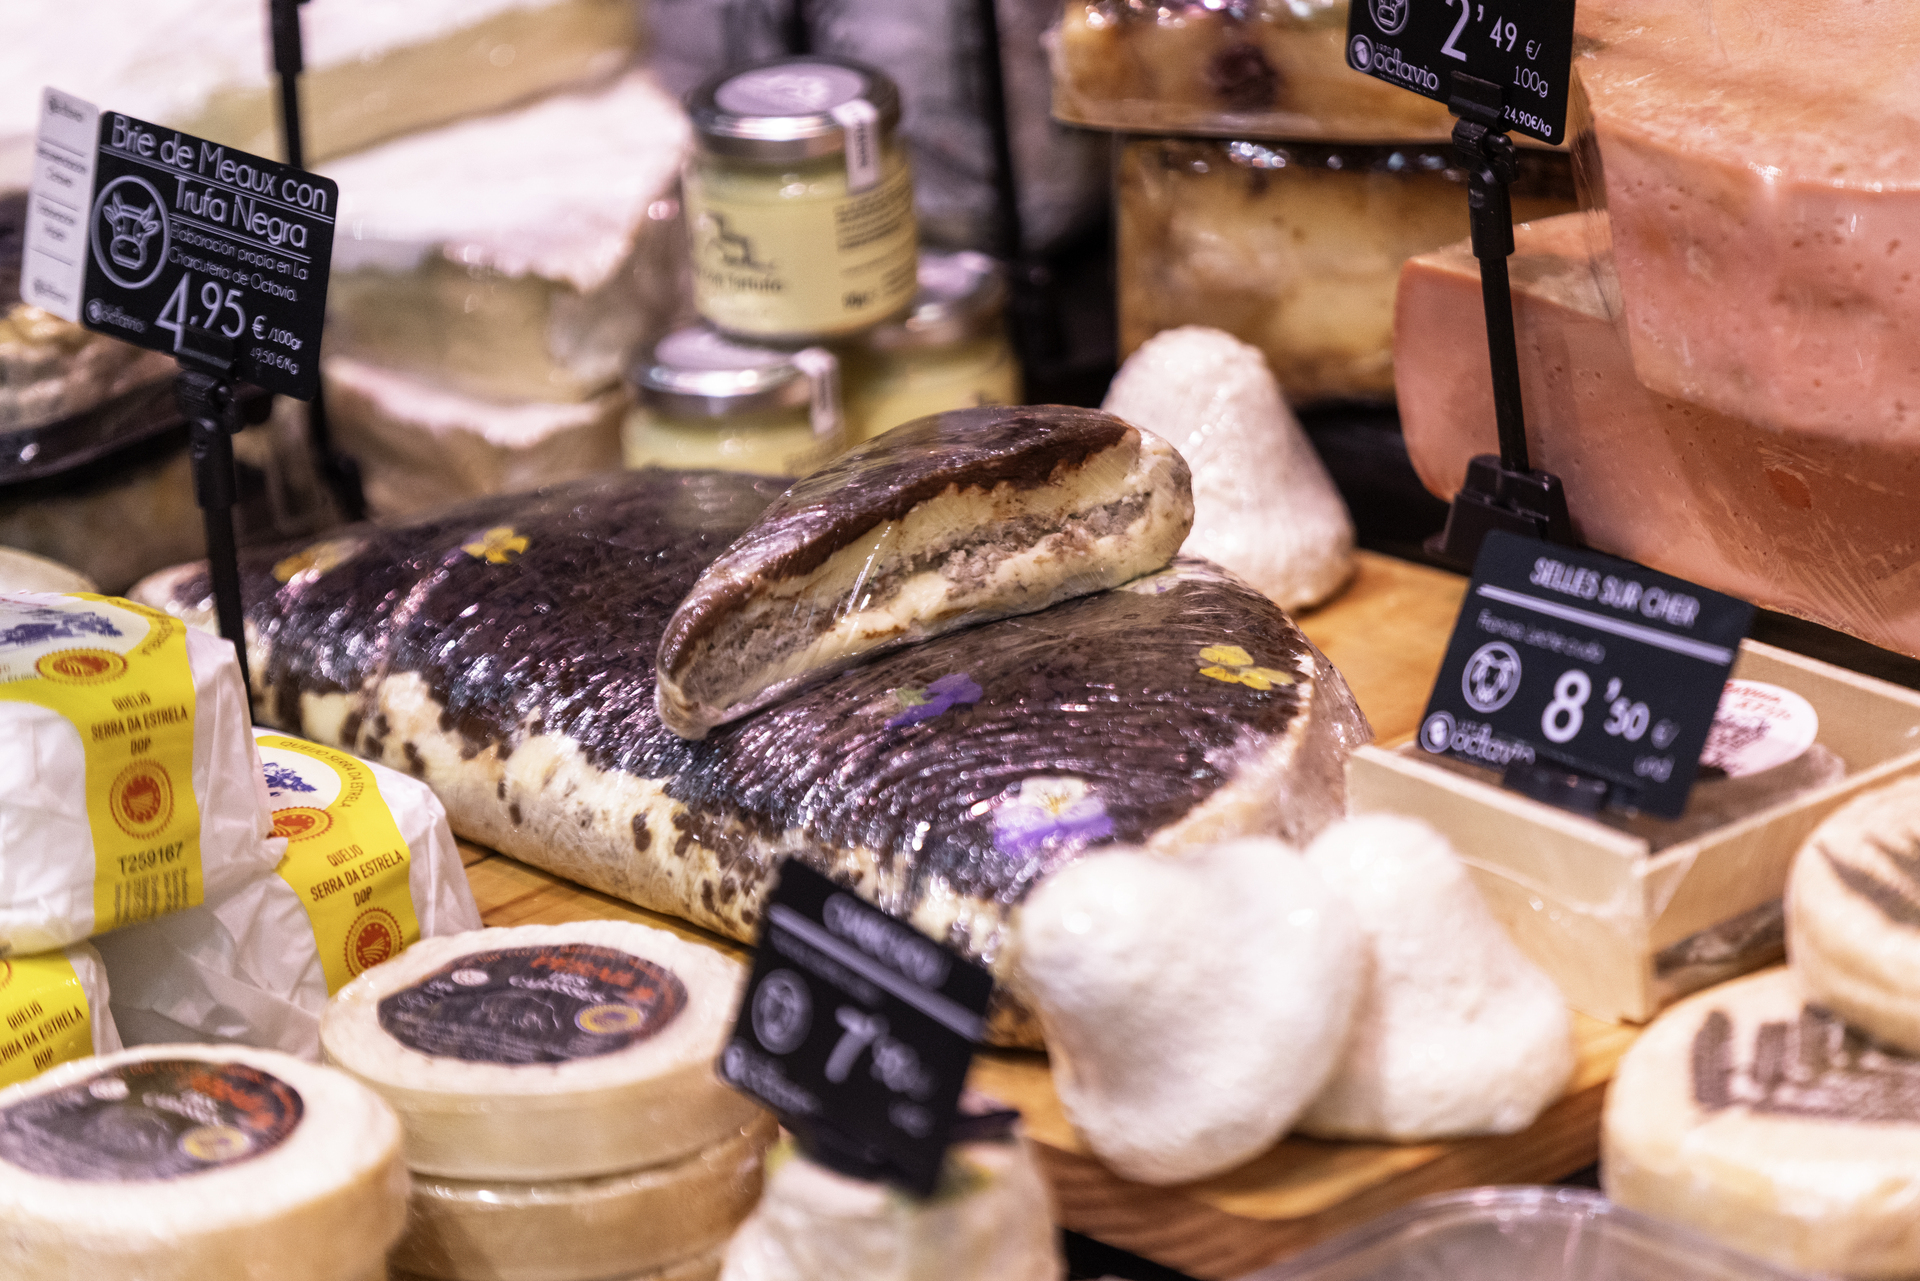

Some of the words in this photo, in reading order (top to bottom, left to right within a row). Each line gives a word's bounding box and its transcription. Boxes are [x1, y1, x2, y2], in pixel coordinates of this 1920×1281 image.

[1374, 48, 1440, 91] octavio
[1513, 65, 1549, 98] 100g
[111, 114, 157, 157] Brie
[160, 133, 195, 169] de
[199, 141, 278, 196] Meaux
[281, 178, 328, 213] con
[174, 175, 229, 223] Trufa
[232, 195, 308, 248] Negra
[232, 268, 250, 286] de
[238, 249, 277, 268] propia
[277, 261, 292, 274] en
[293, 261, 309, 280] La
[251, 315, 267, 340] €
[91, 719, 126, 742] SERRA
[127, 715, 142, 734] DA
[143, 704, 188, 730] ESTRELA
[131, 737, 151, 756] DOP
[327, 844, 364, 867] QUEIJO
[310, 875, 346, 902] SERRA
[346, 869, 361, 886] DA
[360, 849, 405, 880] ESTRELA
[353, 886, 372, 907] DOP
